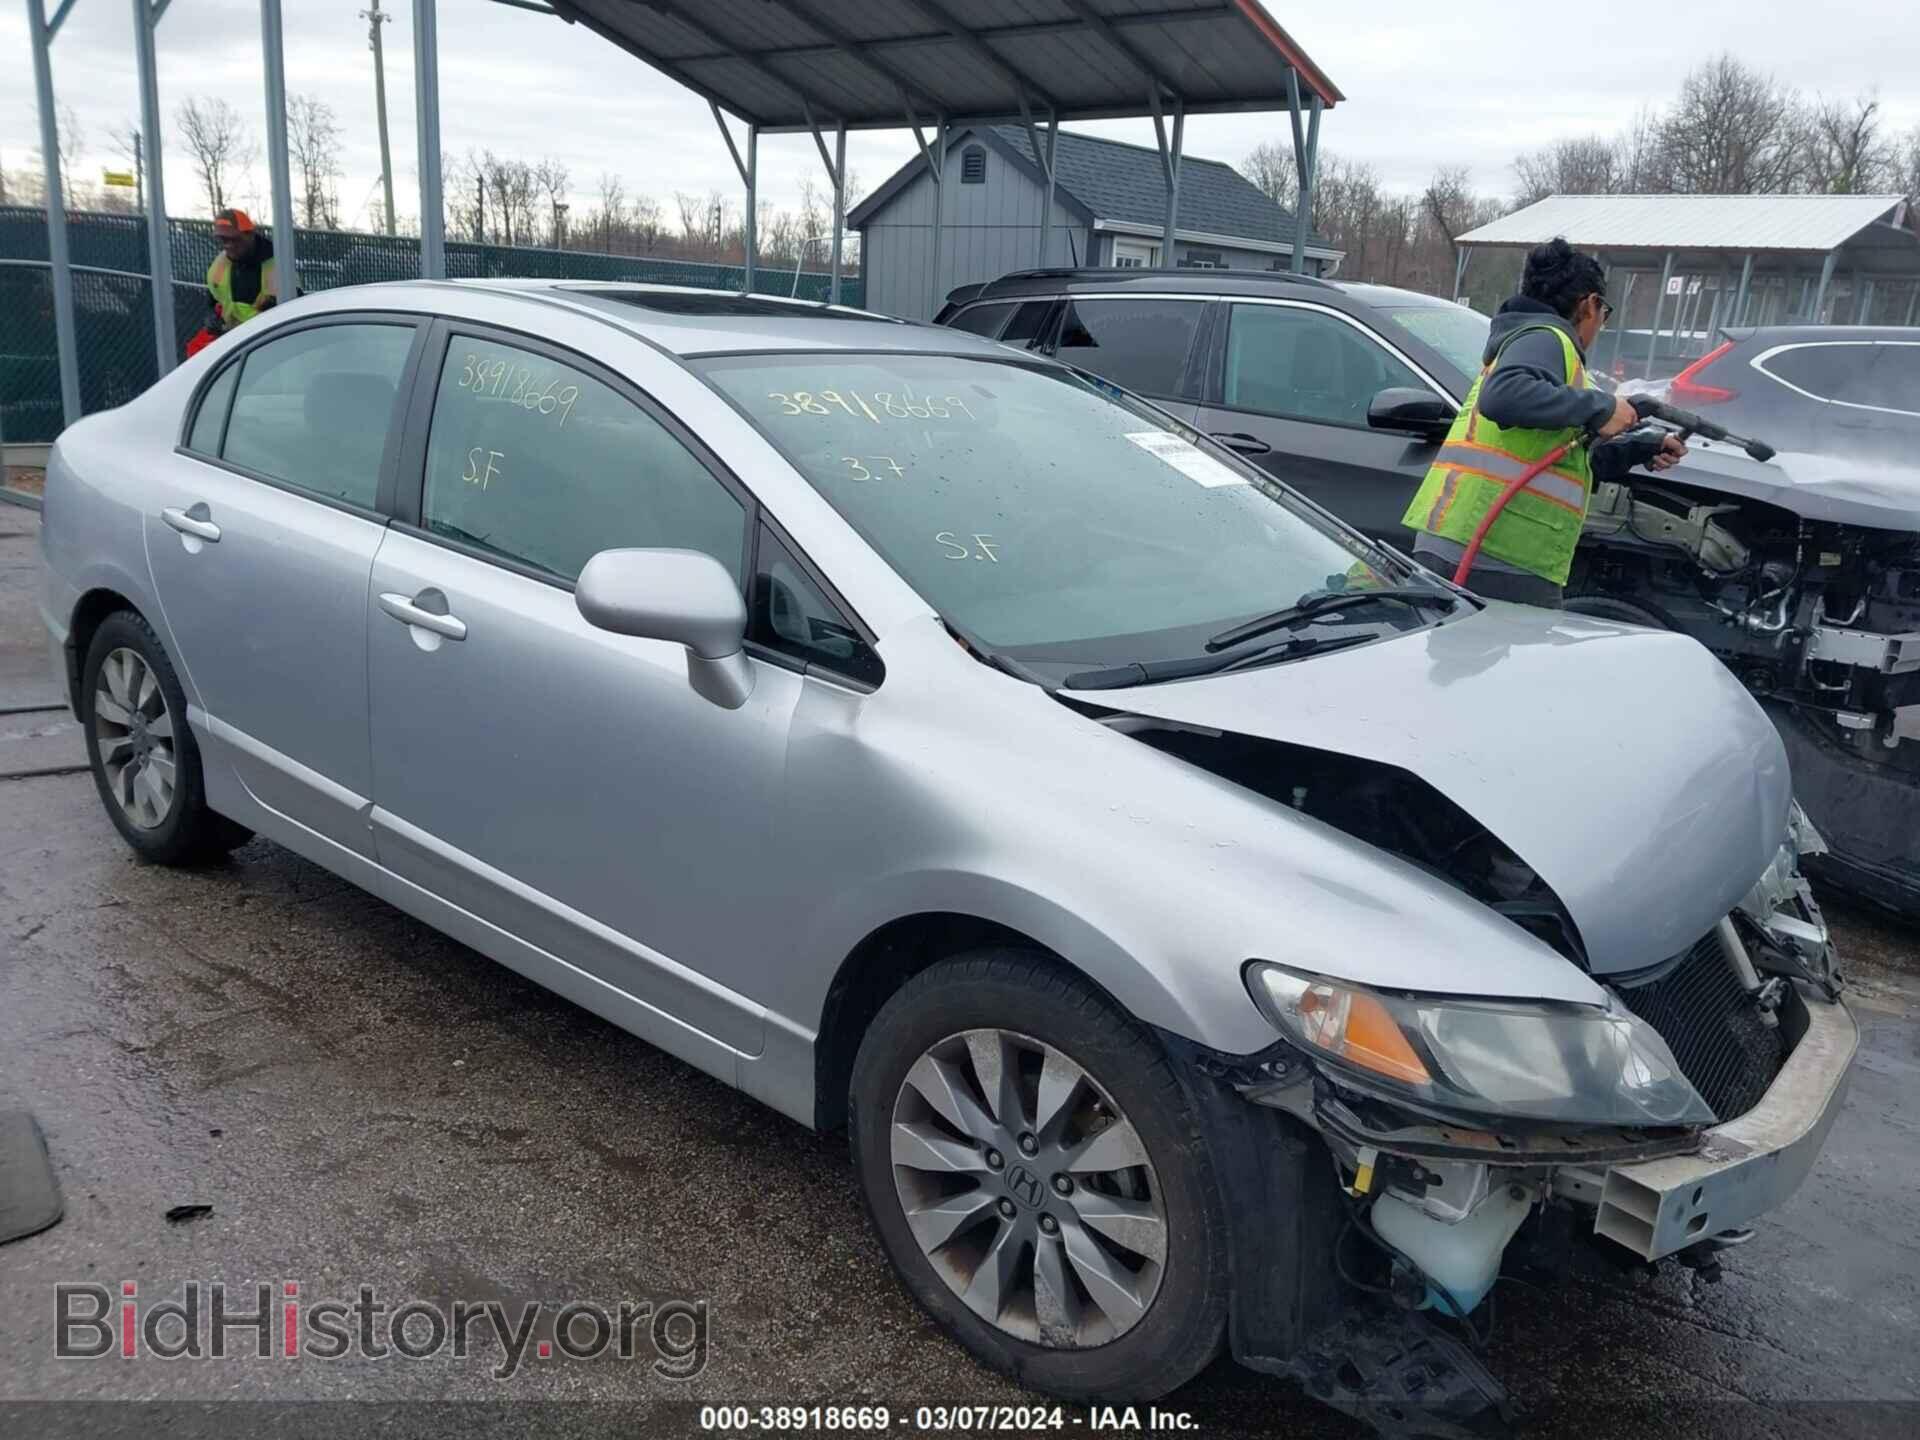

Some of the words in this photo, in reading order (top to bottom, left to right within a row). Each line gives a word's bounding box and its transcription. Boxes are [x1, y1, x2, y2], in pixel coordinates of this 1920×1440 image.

[458, 354, 578, 427] 38918669
[768, 388, 977, 424] 38918669
[462, 447, 505, 491] S.F
[841, 456, 904, 481] 3.7
[935, 531, 1001, 562] S.F
